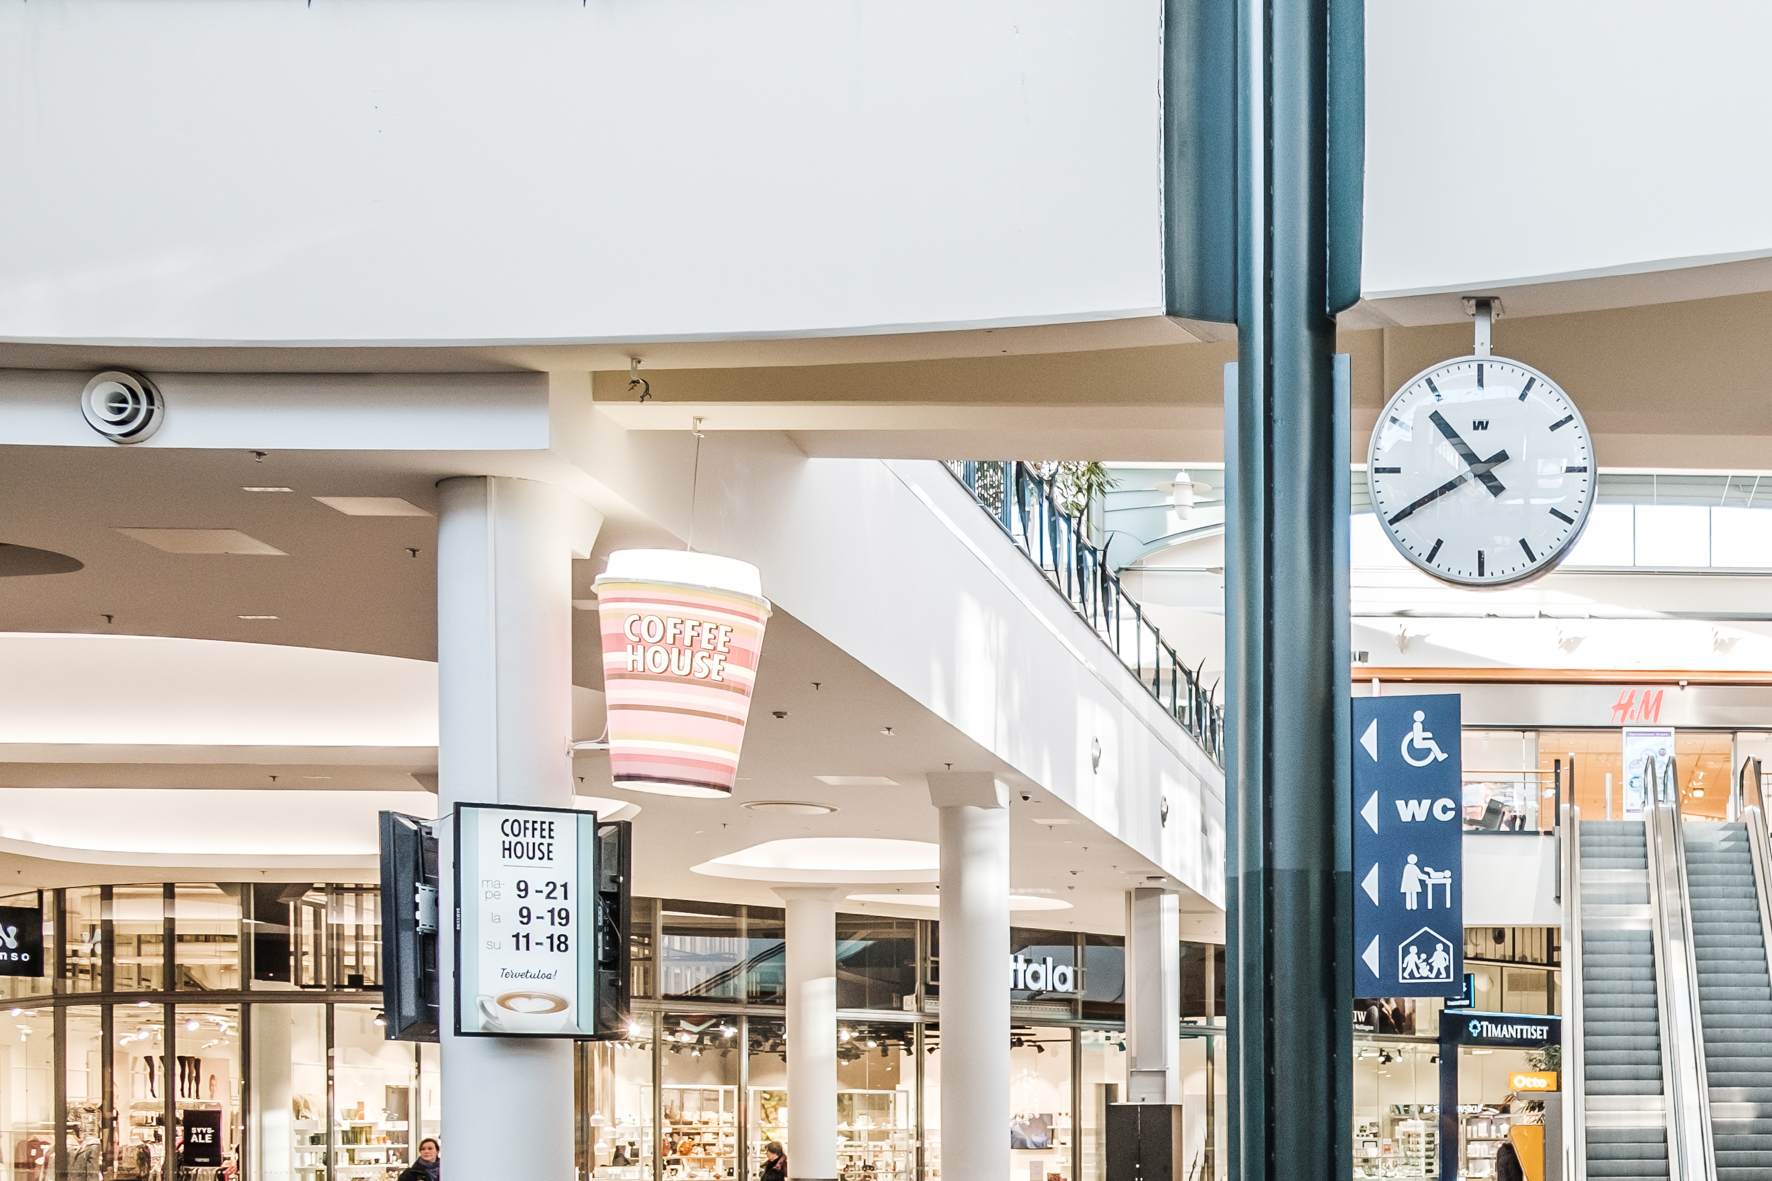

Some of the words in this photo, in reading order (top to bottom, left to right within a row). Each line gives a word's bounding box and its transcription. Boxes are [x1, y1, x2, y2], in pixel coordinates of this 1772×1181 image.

[624, 614, 733, 653] COFFEE
[626, 644, 727, 682] HOUSE
[1610, 688, 1664, 724] H&M
[1396, 798, 1455, 822] WC
[501, 818, 555, 840] COFFEE
[502, 840, 553, 861] HOUSE
[481, 879, 505, 889] ma-
[485, 889, 501, 902] pe
[491, 912, 501, 924] la
[486, 939, 501, 950] su
[511, 932, 569, 953] 11-18
[0, 951, 30, 962] nso
[500, 967, 558, 981] Tervetuloa!
[1009, 954, 1074, 992] ttala
[1481, 1021, 1549, 1040] TIMANTTISET
[190, 1134, 213, 1143] ALE
